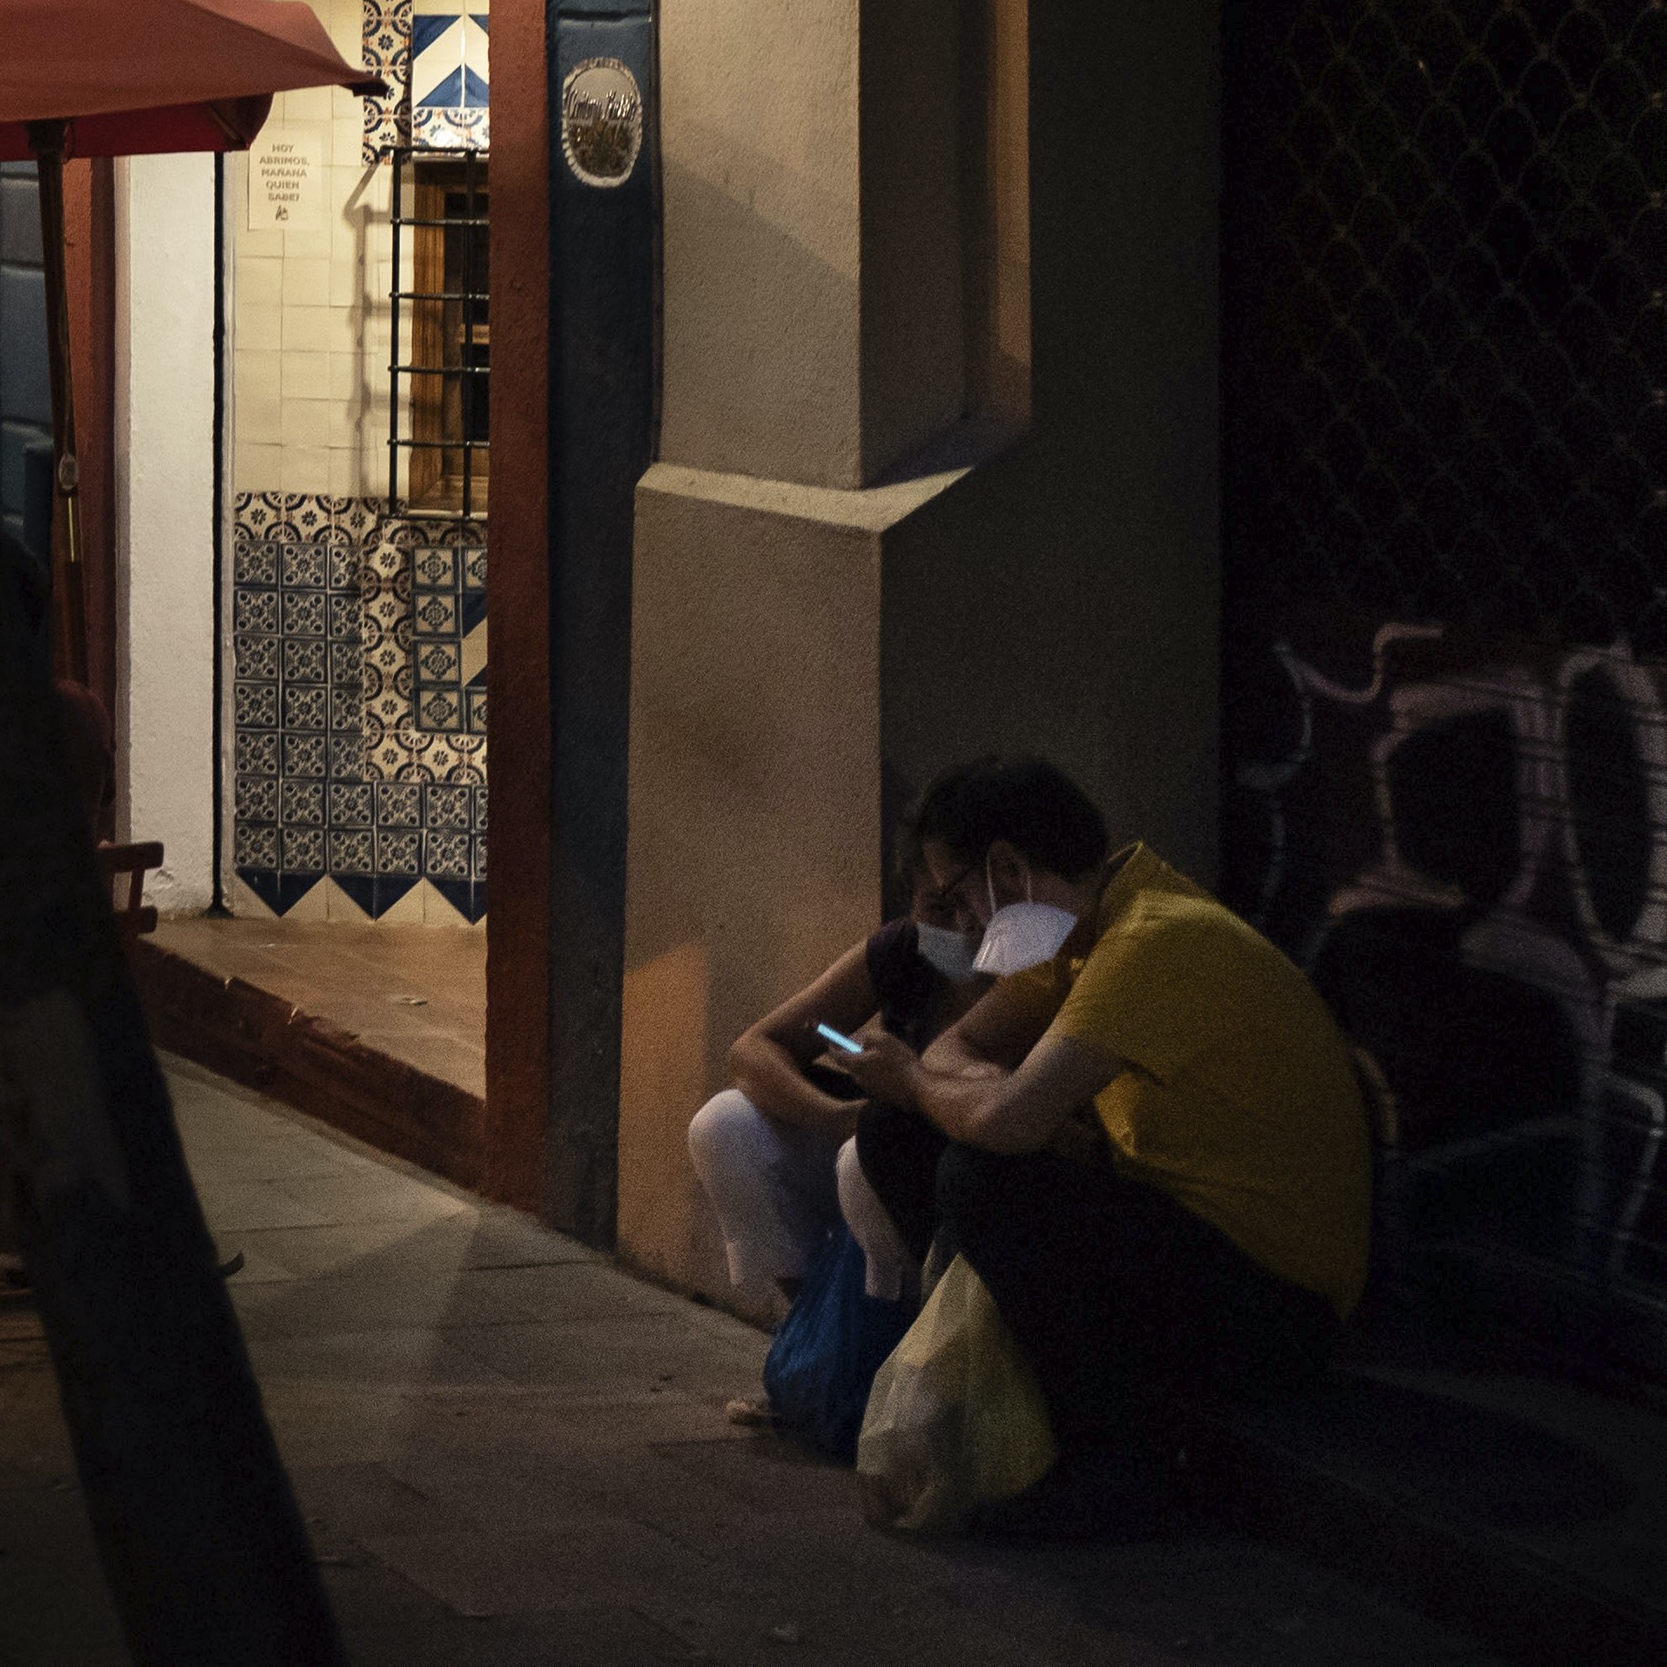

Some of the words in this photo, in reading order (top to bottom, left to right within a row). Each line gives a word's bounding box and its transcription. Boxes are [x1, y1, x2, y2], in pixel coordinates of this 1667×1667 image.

[271, 144, 294, 153] HOY
[261, 167, 307, 177] MAÑANA
[265, 180, 300, 190] QUIEN
